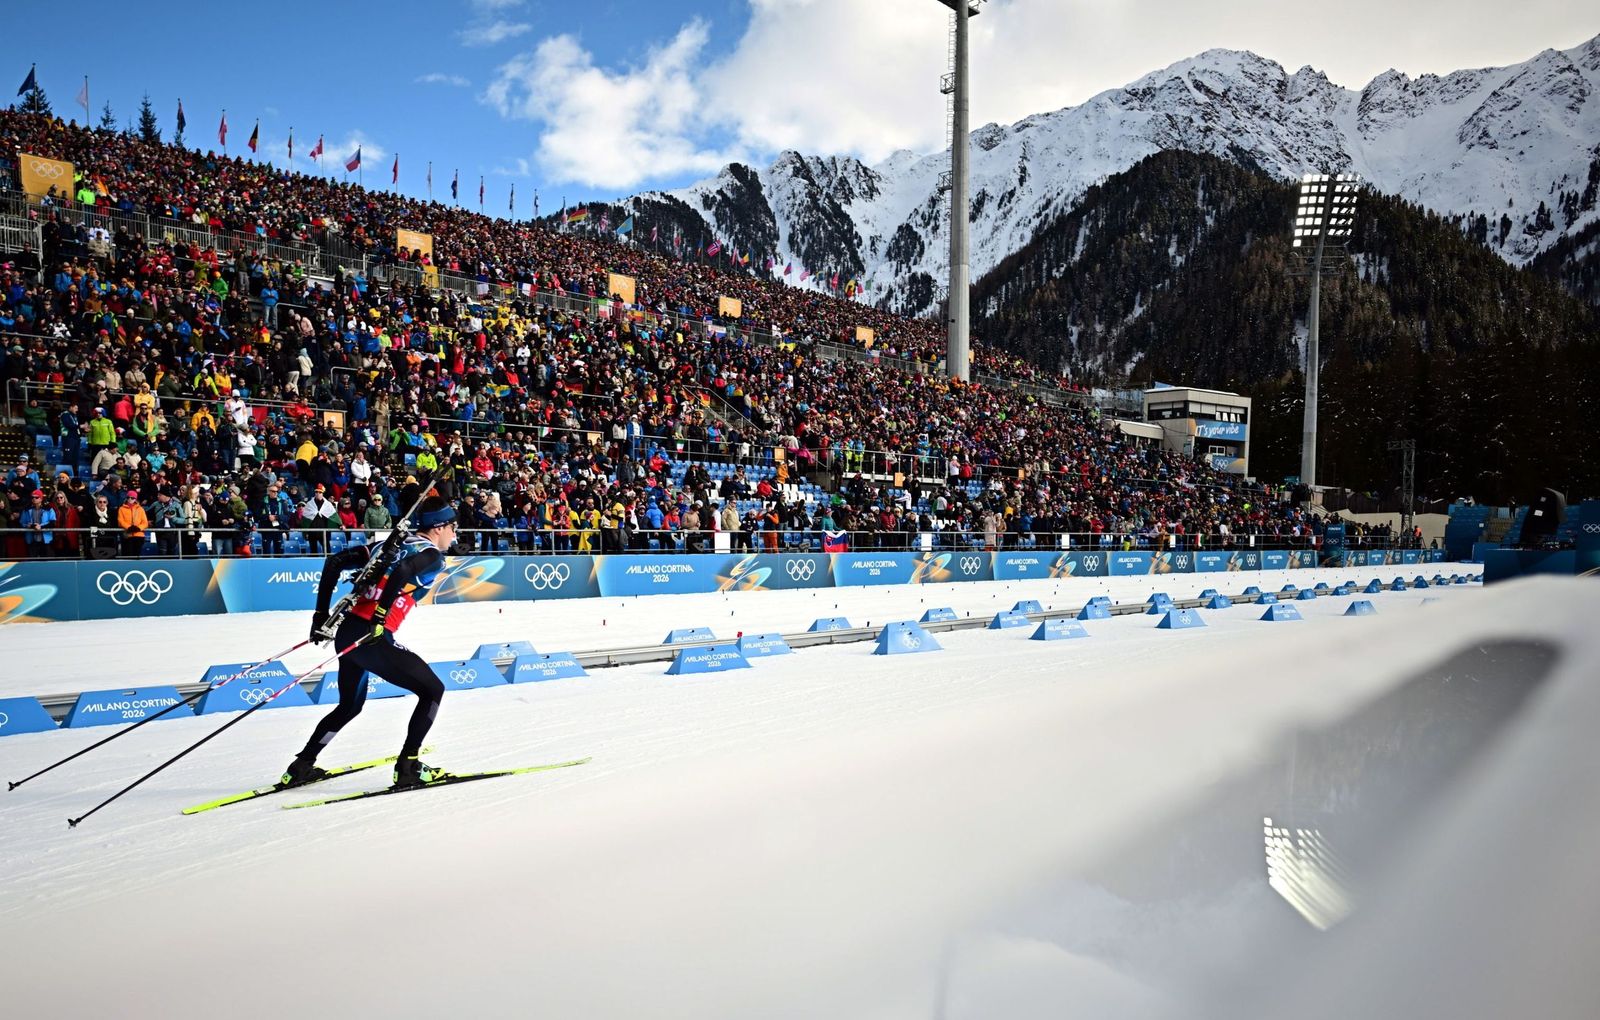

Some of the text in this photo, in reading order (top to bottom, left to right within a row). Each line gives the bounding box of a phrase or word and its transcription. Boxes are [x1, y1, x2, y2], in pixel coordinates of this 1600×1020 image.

[1208, 427, 1225, 438] your
[625, 564, 694, 574] MILANO CORTINA
[652, 574, 669, 583] 2026
[684, 652, 740, 663] MILANO CORTINA
[519, 660, 576, 671] MILANO CORTINA
[249, 669, 287, 679] CORTINA
[82, 697, 180, 713] MILANO CORTINA
[122, 709, 145, 719] 2026
